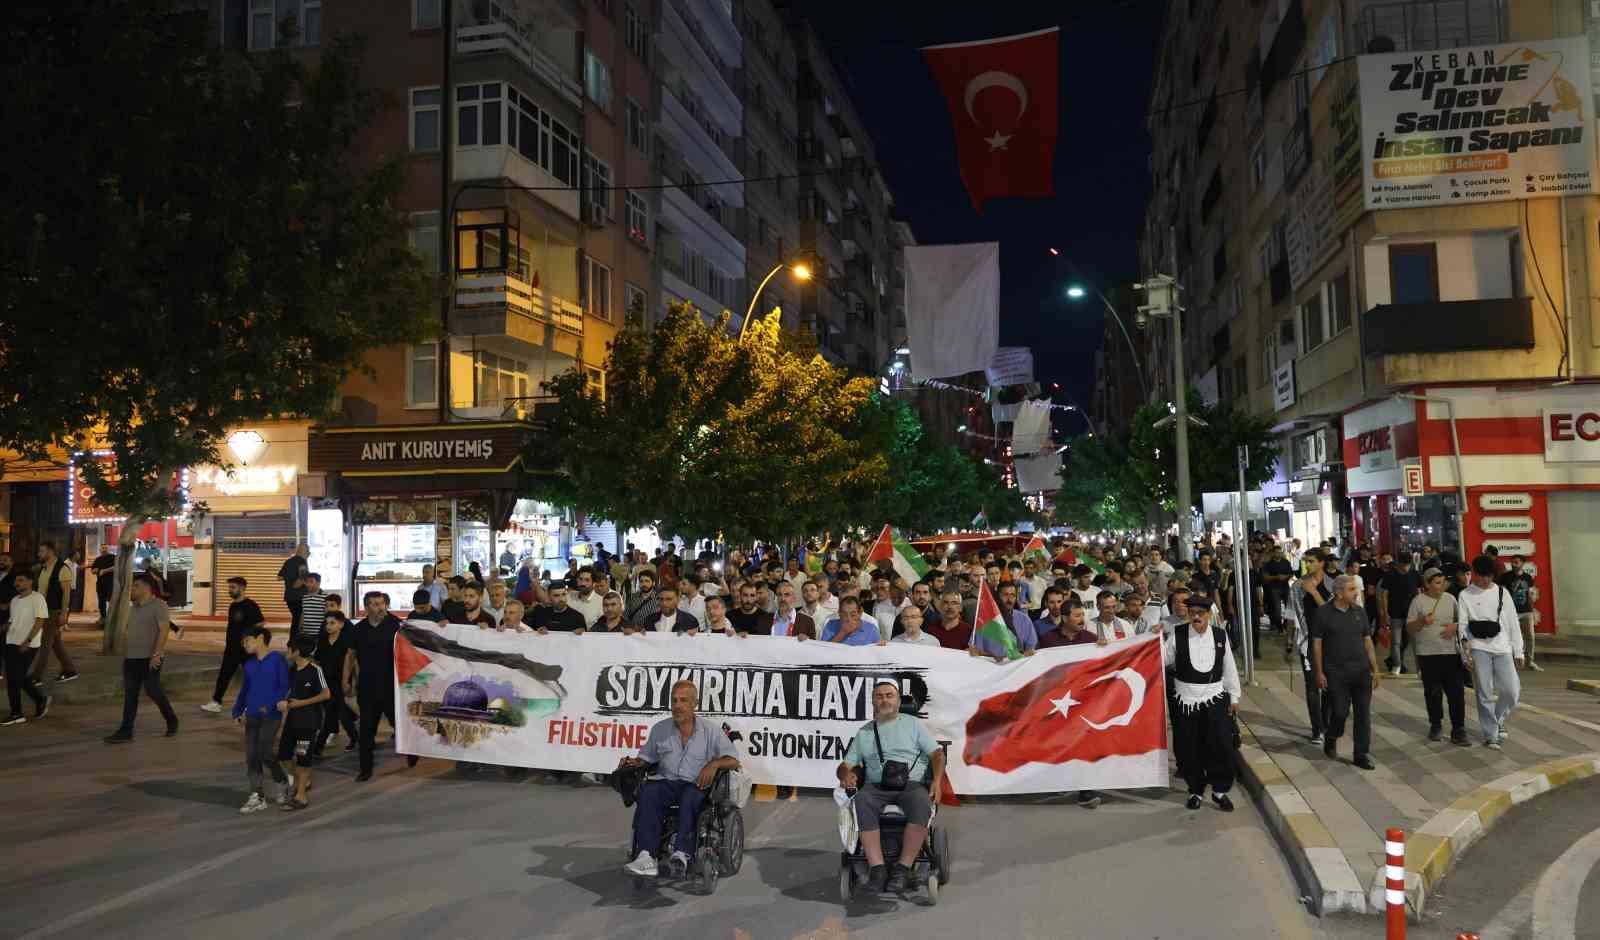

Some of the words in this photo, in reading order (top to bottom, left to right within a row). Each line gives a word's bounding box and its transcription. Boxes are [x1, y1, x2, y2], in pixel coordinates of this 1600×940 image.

[1414, 50, 1495, 70] KEBAN
[1434, 87, 1503, 110] Dev
[1395, 102, 1551, 134] Salıncak
[1468, 126, 1584, 153] Sapanı
[1550, 413, 1600, 441] EC
[361, 442, 396, 460] ANIT
[402, 439, 493, 460] KURUYEMİŞ
[1409, 472, 1419, 490] E
[799, 673, 911, 720] HAYI!
[548, 716, 648, 749] FİLİSTİNE
